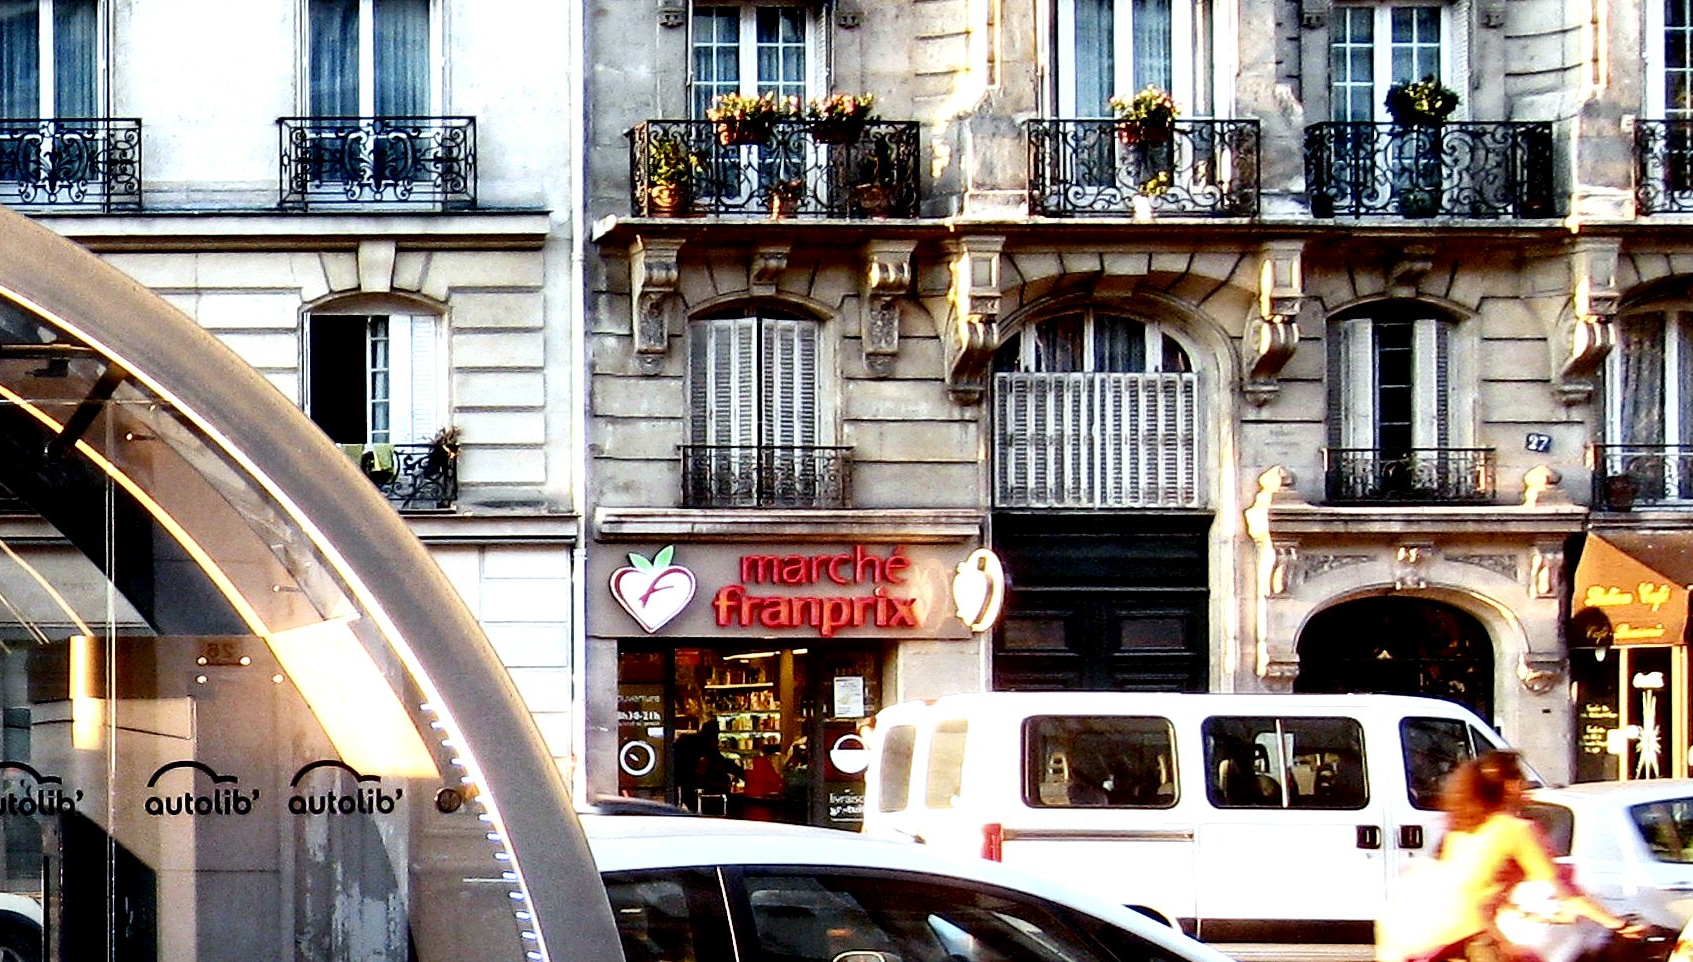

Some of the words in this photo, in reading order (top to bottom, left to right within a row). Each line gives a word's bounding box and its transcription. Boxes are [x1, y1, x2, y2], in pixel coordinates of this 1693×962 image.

[1528, 434, 1549, 451] 27
[739, 545, 910, 585] marché
[711, 583, 917, 637] franprix
[145, 789, 260, 816] autolib'
[288, 788, 403, 815] autolib'
